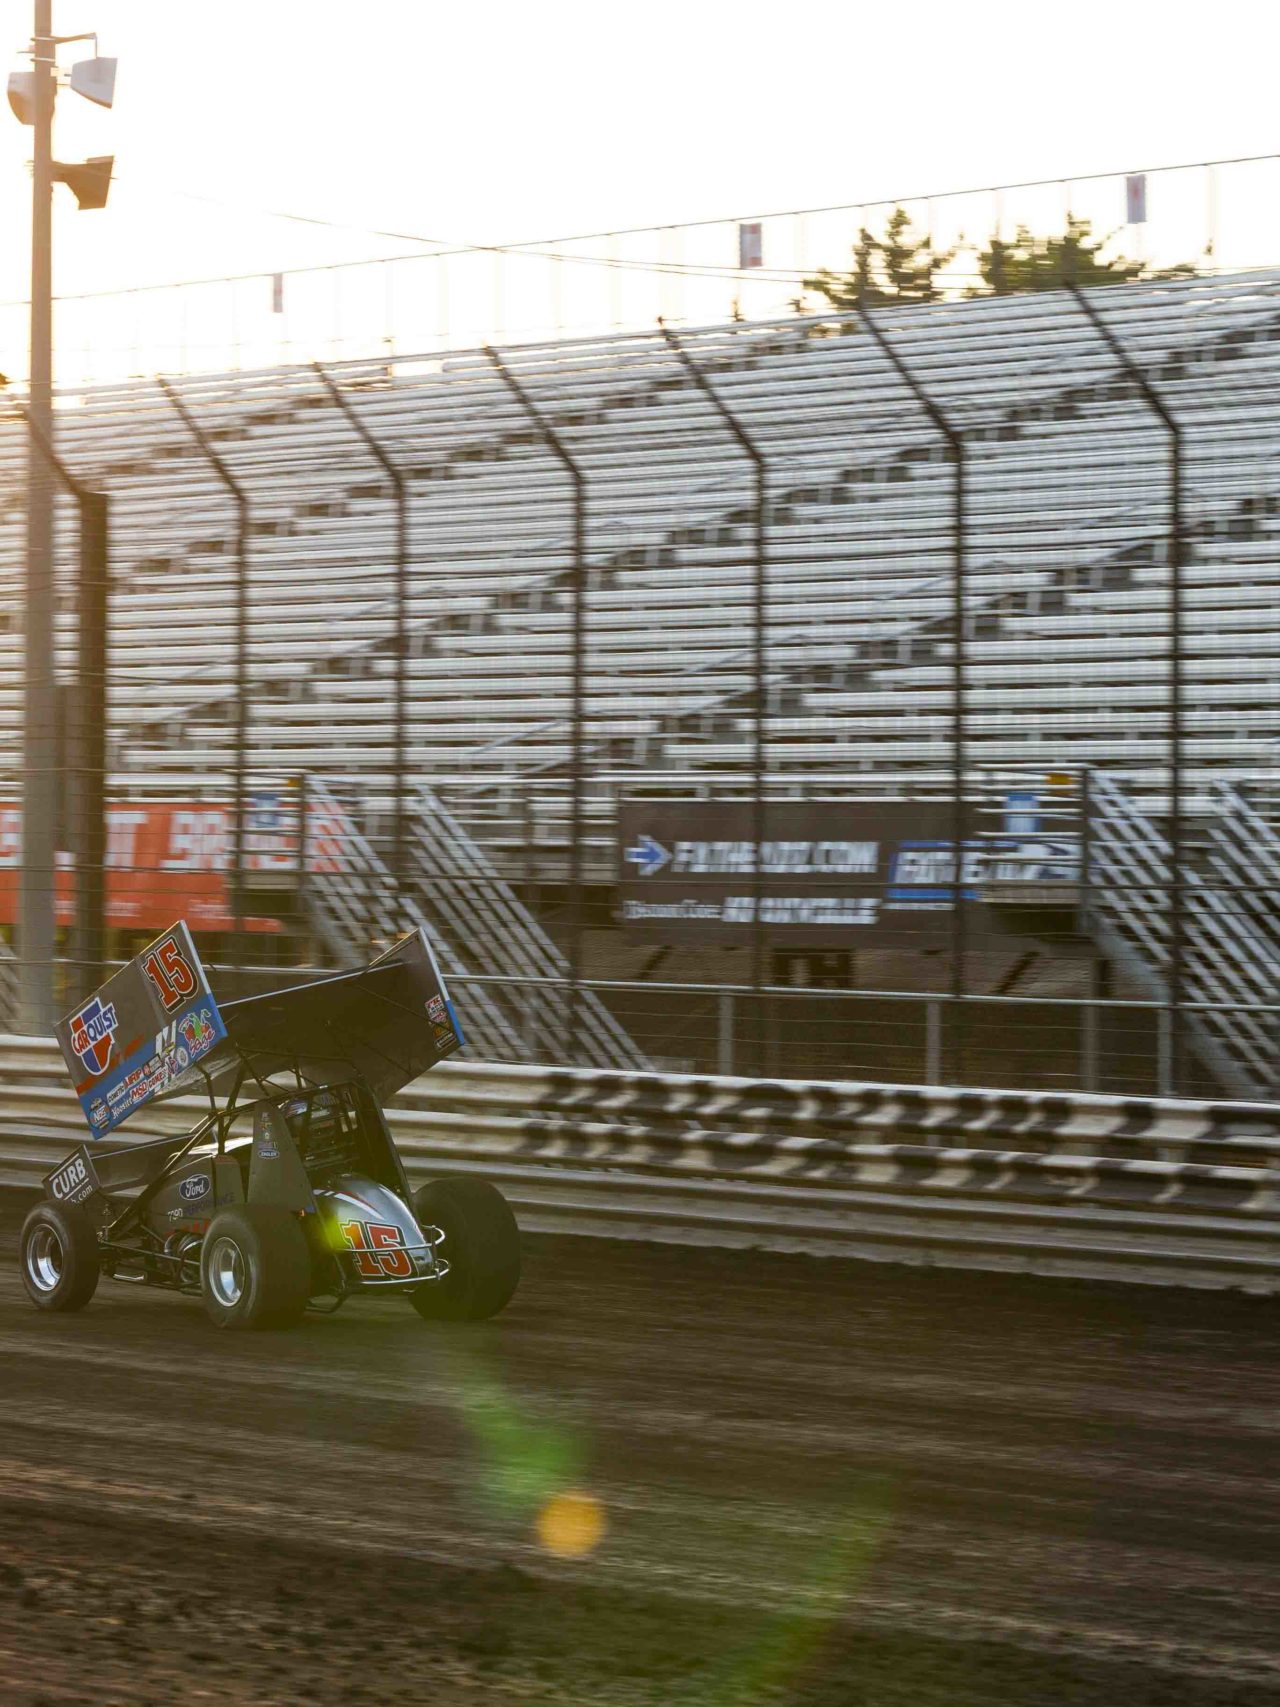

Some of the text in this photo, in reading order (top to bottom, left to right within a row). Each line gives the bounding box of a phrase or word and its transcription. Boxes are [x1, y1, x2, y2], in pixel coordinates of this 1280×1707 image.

[141, 935, 198, 1014] 15
[71, 1003, 117, 1056] CARQUIST
[52, 1158, 86, 1199] CURB
[185, 1174, 207, 1197] Ford
[338, 1219, 418, 1280] 15
